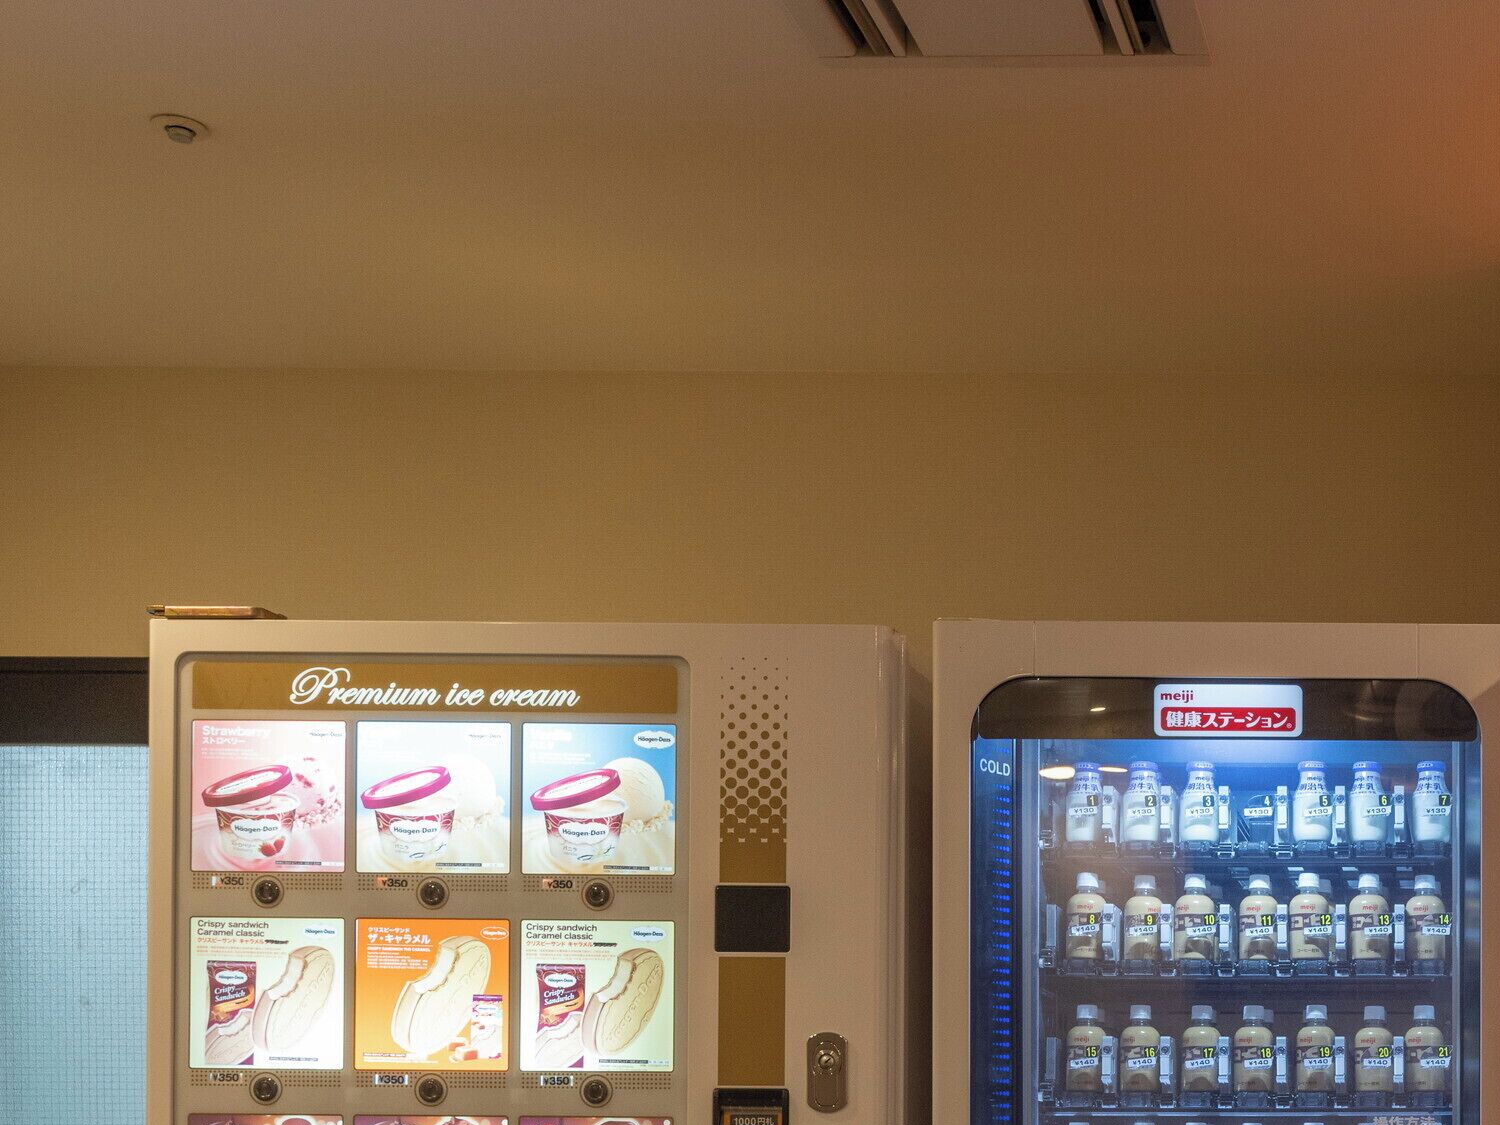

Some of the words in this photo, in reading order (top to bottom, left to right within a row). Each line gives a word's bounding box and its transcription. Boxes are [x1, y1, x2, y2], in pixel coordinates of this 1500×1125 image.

[290, 667, 441, 705] Premium
[445, 682, 484, 705] ice
[489, 687, 580, 707] cream
[1160, 690, 1194, 703] meiji
[1165, 711, 1291, 729] 健康ステーション
[202, 726, 271, 739] Strawberry
[979, 759, 1011, 776] COLD
[1148, 796, 1153, 805] 2
[1206, 796, 1211, 806] 3
[1439, 915, 1449, 924] 14
[197, 920, 225, 929] Crispy
[197, 928, 233, 936] Caramel
[236, 929, 264, 937] classic
[526, 932, 562, 940] Caramel
[368, 934, 431, 944] ザ・キャラメル
[1086, 1047, 1096, 1056] 15
[1145, 1048, 1154, 1057] 16
[1204, 1048, 1213, 1057] 17
[1261, 1049, 1271, 1057] 18
[1320, 1048, 1330, 1056] 19
[1379, 1049, 1389, 1057] 20
[1439, 1048, 1448, 1056] 21
